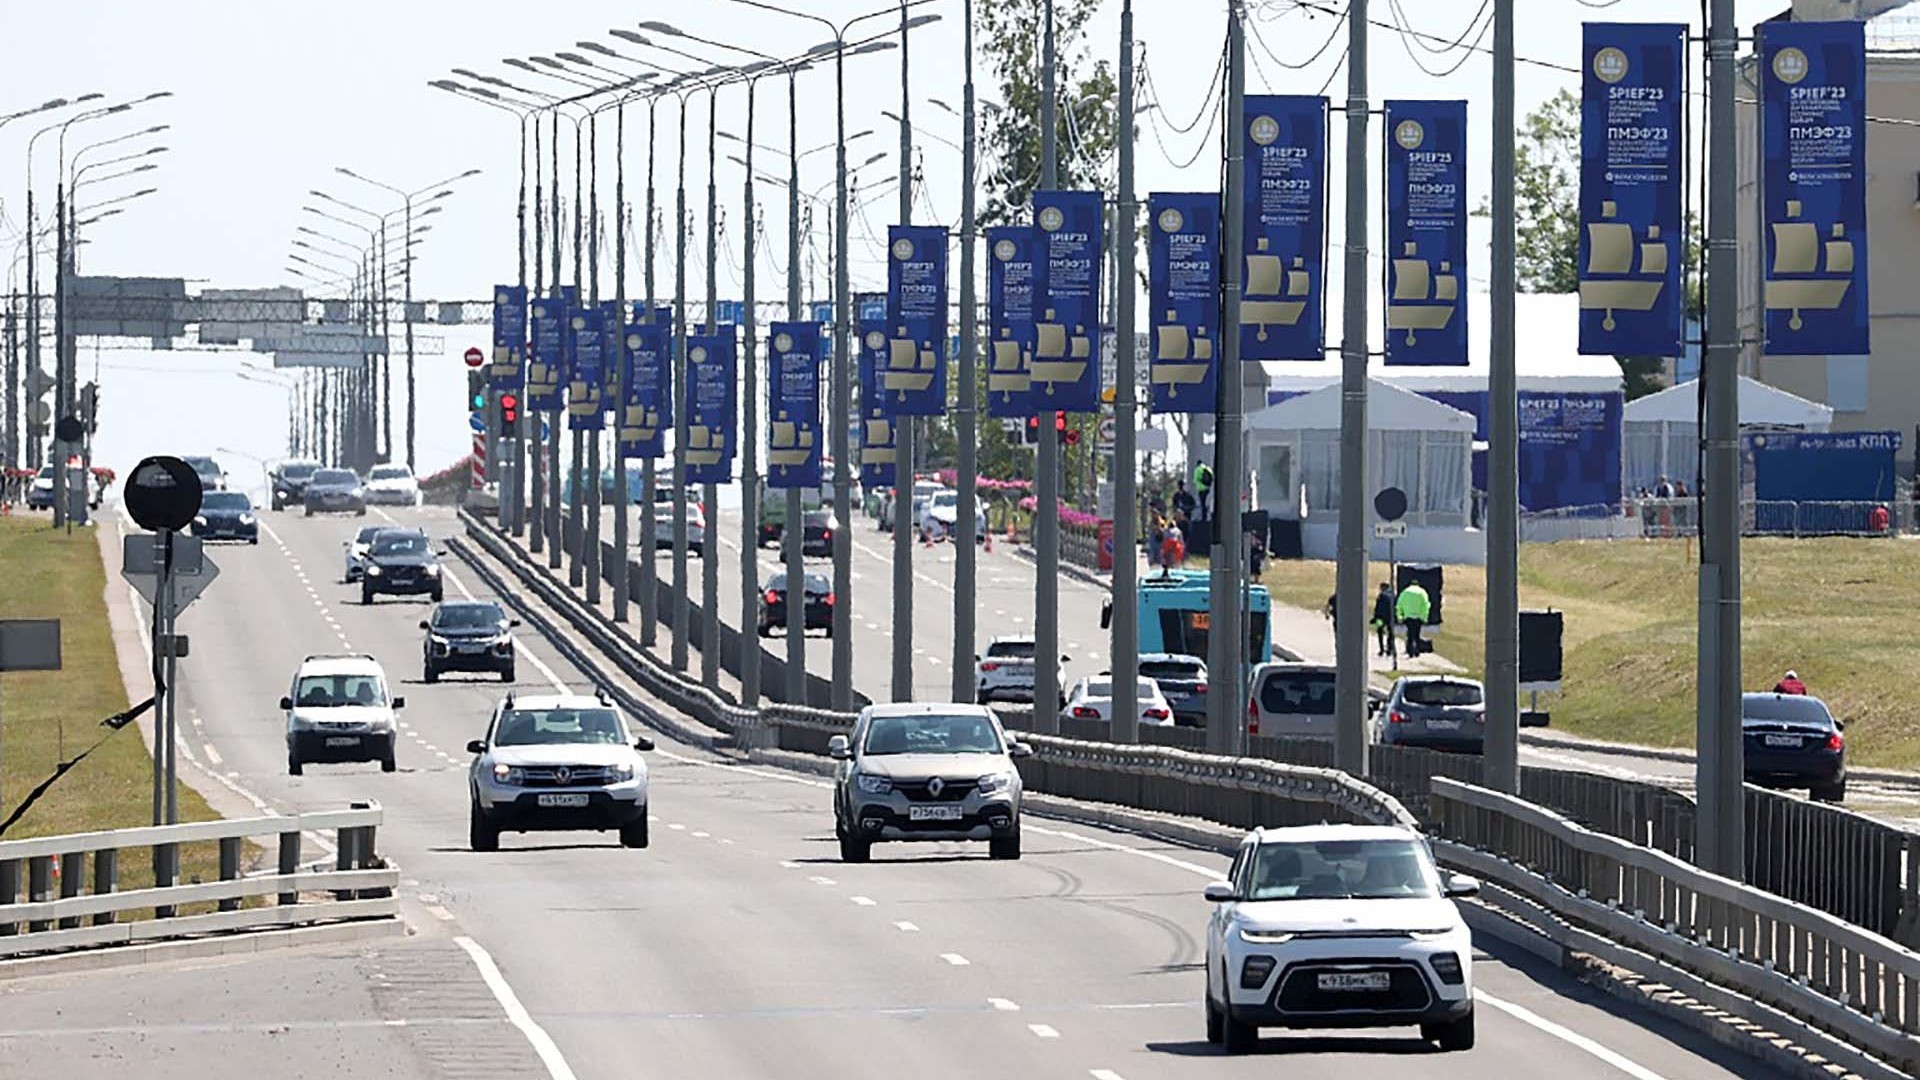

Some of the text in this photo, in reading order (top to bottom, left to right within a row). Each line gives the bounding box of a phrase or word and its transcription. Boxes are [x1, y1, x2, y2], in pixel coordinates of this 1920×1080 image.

[1609, 87, 1664, 100] SPIEF'23
[1790, 87, 1846, 99] SPIEF'23
[1608, 127, 1668, 140] ПМЭФ'23
[1790, 126, 1852, 139] ПМЭФ'23
